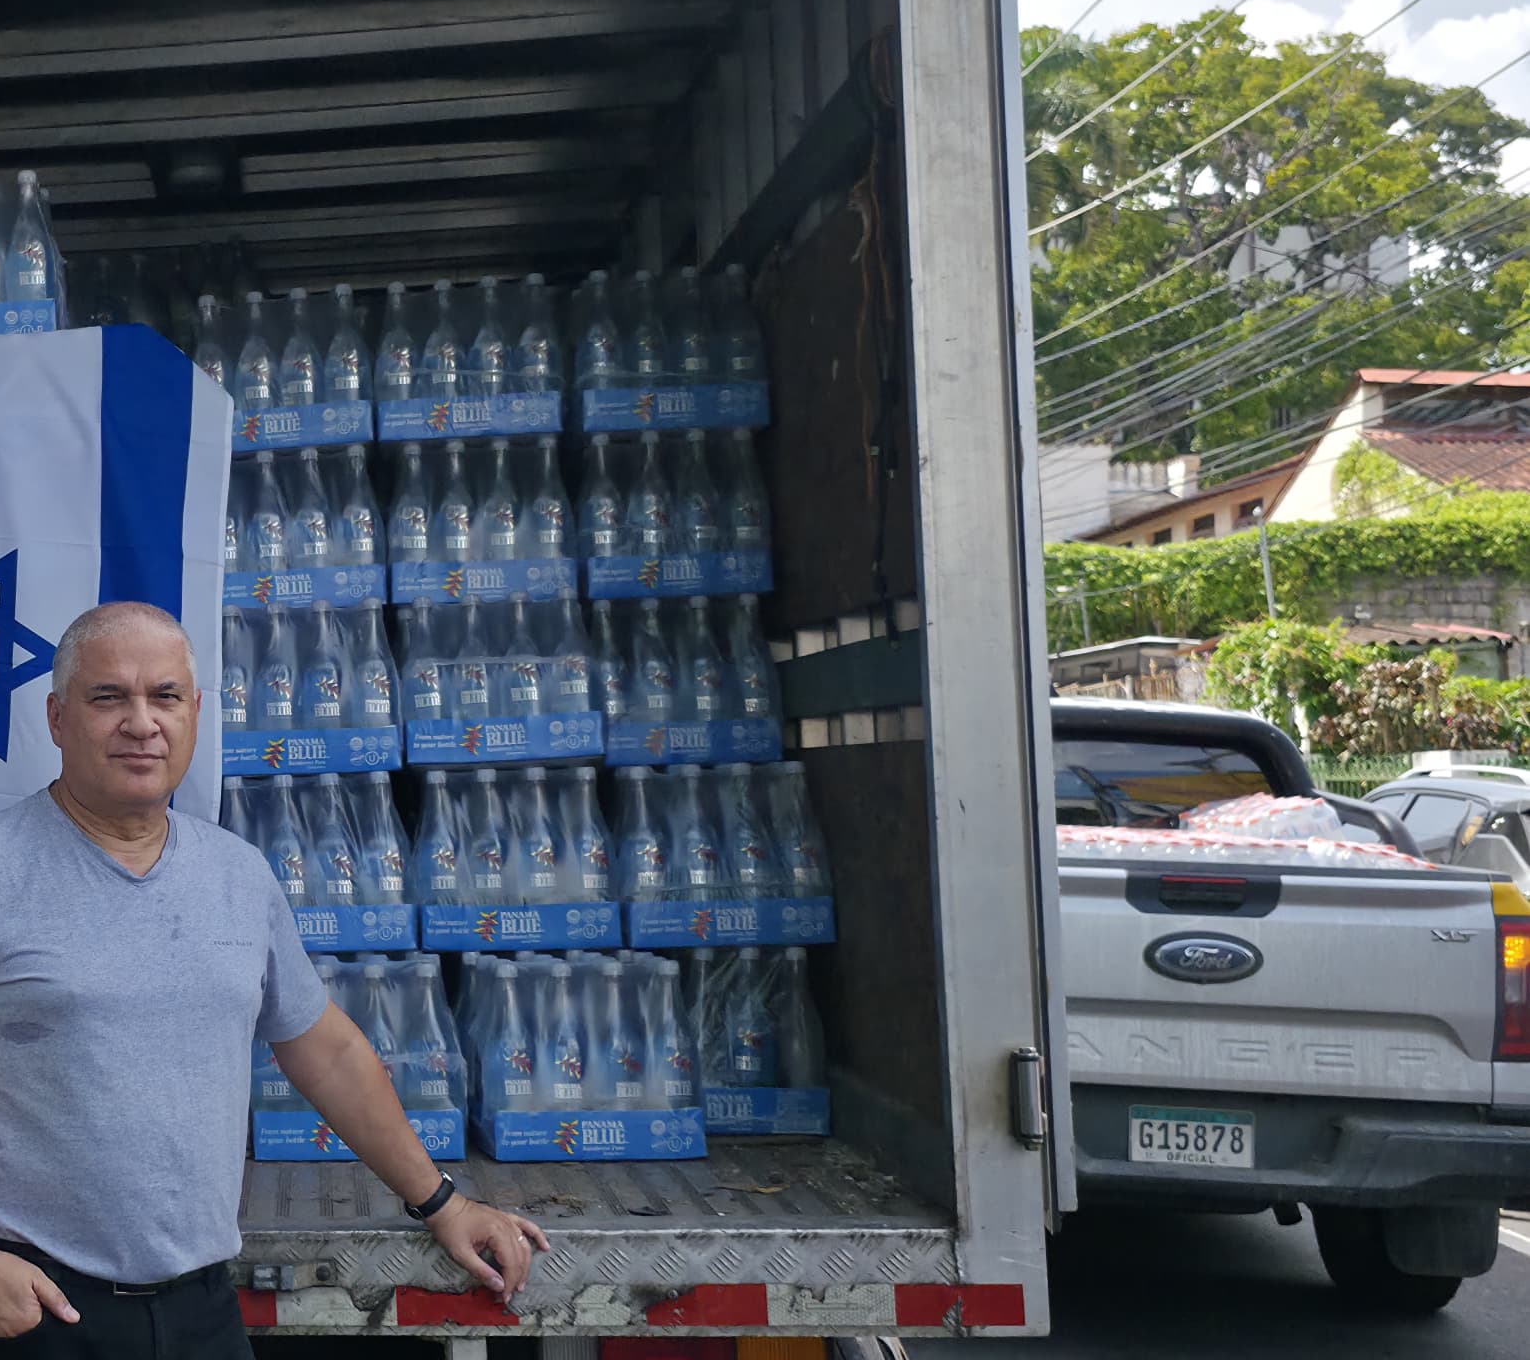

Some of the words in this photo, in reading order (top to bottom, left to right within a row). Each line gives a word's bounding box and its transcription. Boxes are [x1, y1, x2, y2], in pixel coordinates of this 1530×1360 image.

[453, 408, 491, 422] BLUE
[265, 418, 301, 433] BLUE
[467, 568, 502, 576] PANAMA
[276, 581, 312, 595] BLUE
[467, 575, 505, 588] BLUE
[486, 723, 525, 733] PANAMA
[486, 732, 526, 746] BLUE
[288, 745, 327, 759] BLUE
[297, 912, 336, 920] PANAMA
[500, 911, 540, 919] PANAMA
[298, 920, 338, 935] BLUE
[501, 919, 542, 933] BLUE
[716, 916, 758, 930] BLUE
[1178, 946, 1234, 969] Ford
[1067, 1031, 1442, 1074] ANGER
[263, 1085, 290, 1097] BLUE
[422, 1085, 449, 1096] BLUE
[506, 1085, 532, 1095] BLUE
[706, 1102, 753, 1118] BLUE
[582, 1120, 623, 1128] PANAMA
[582, 1129, 627, 1144] BLUE
[1139, 1121, 1244, 1154] G15878
[1167, 1152, 1214, 1164] OFICIAL
